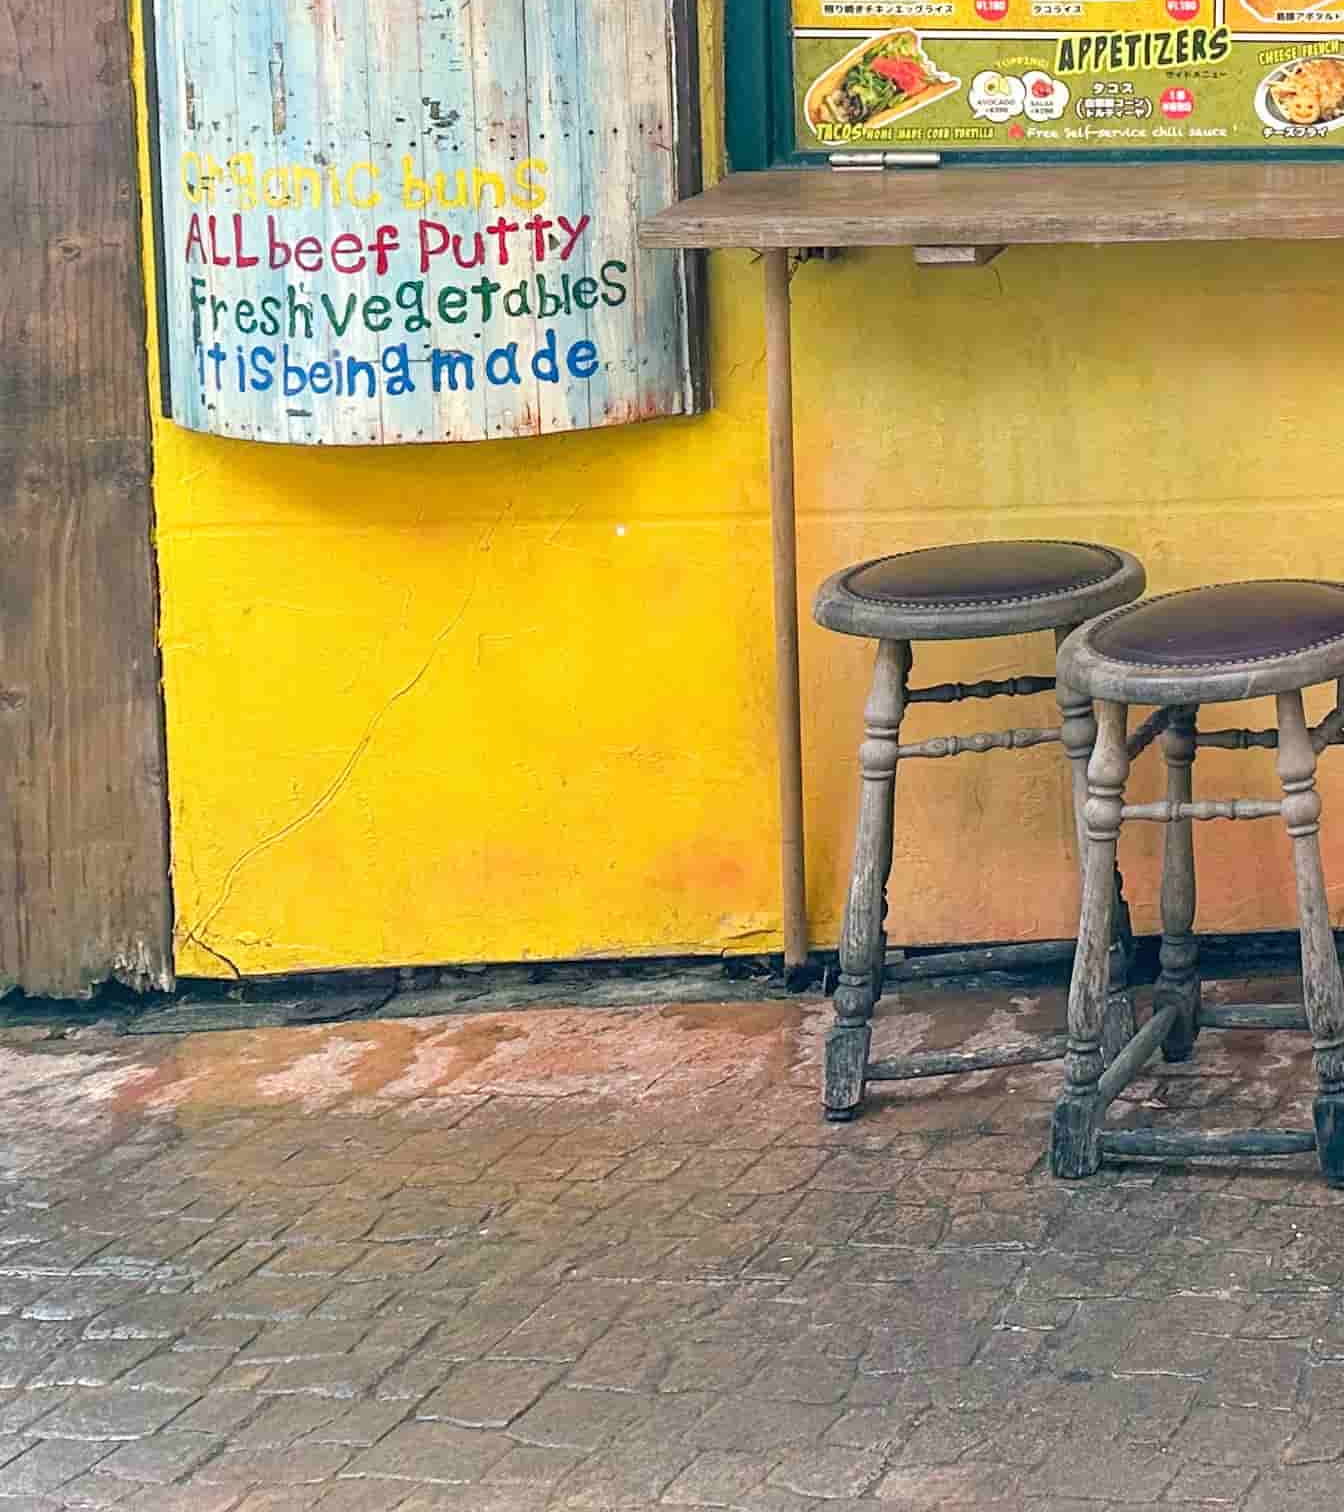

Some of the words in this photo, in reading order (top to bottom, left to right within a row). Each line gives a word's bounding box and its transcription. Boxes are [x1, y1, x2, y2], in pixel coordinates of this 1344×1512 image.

[1032, 3, 1083, 16] タコライス
[1057, 26, 1230, 73] APPETIZERS
[1257, 46, 1298, 66] CHEESE
[1092, 81, 1135, 95] タコス
[814, 122, 865, 141] TACOS
[180, 150, 382, 211] Organic
[401, 154, 549, 211] buns
[431, 329, 600, 392] made
